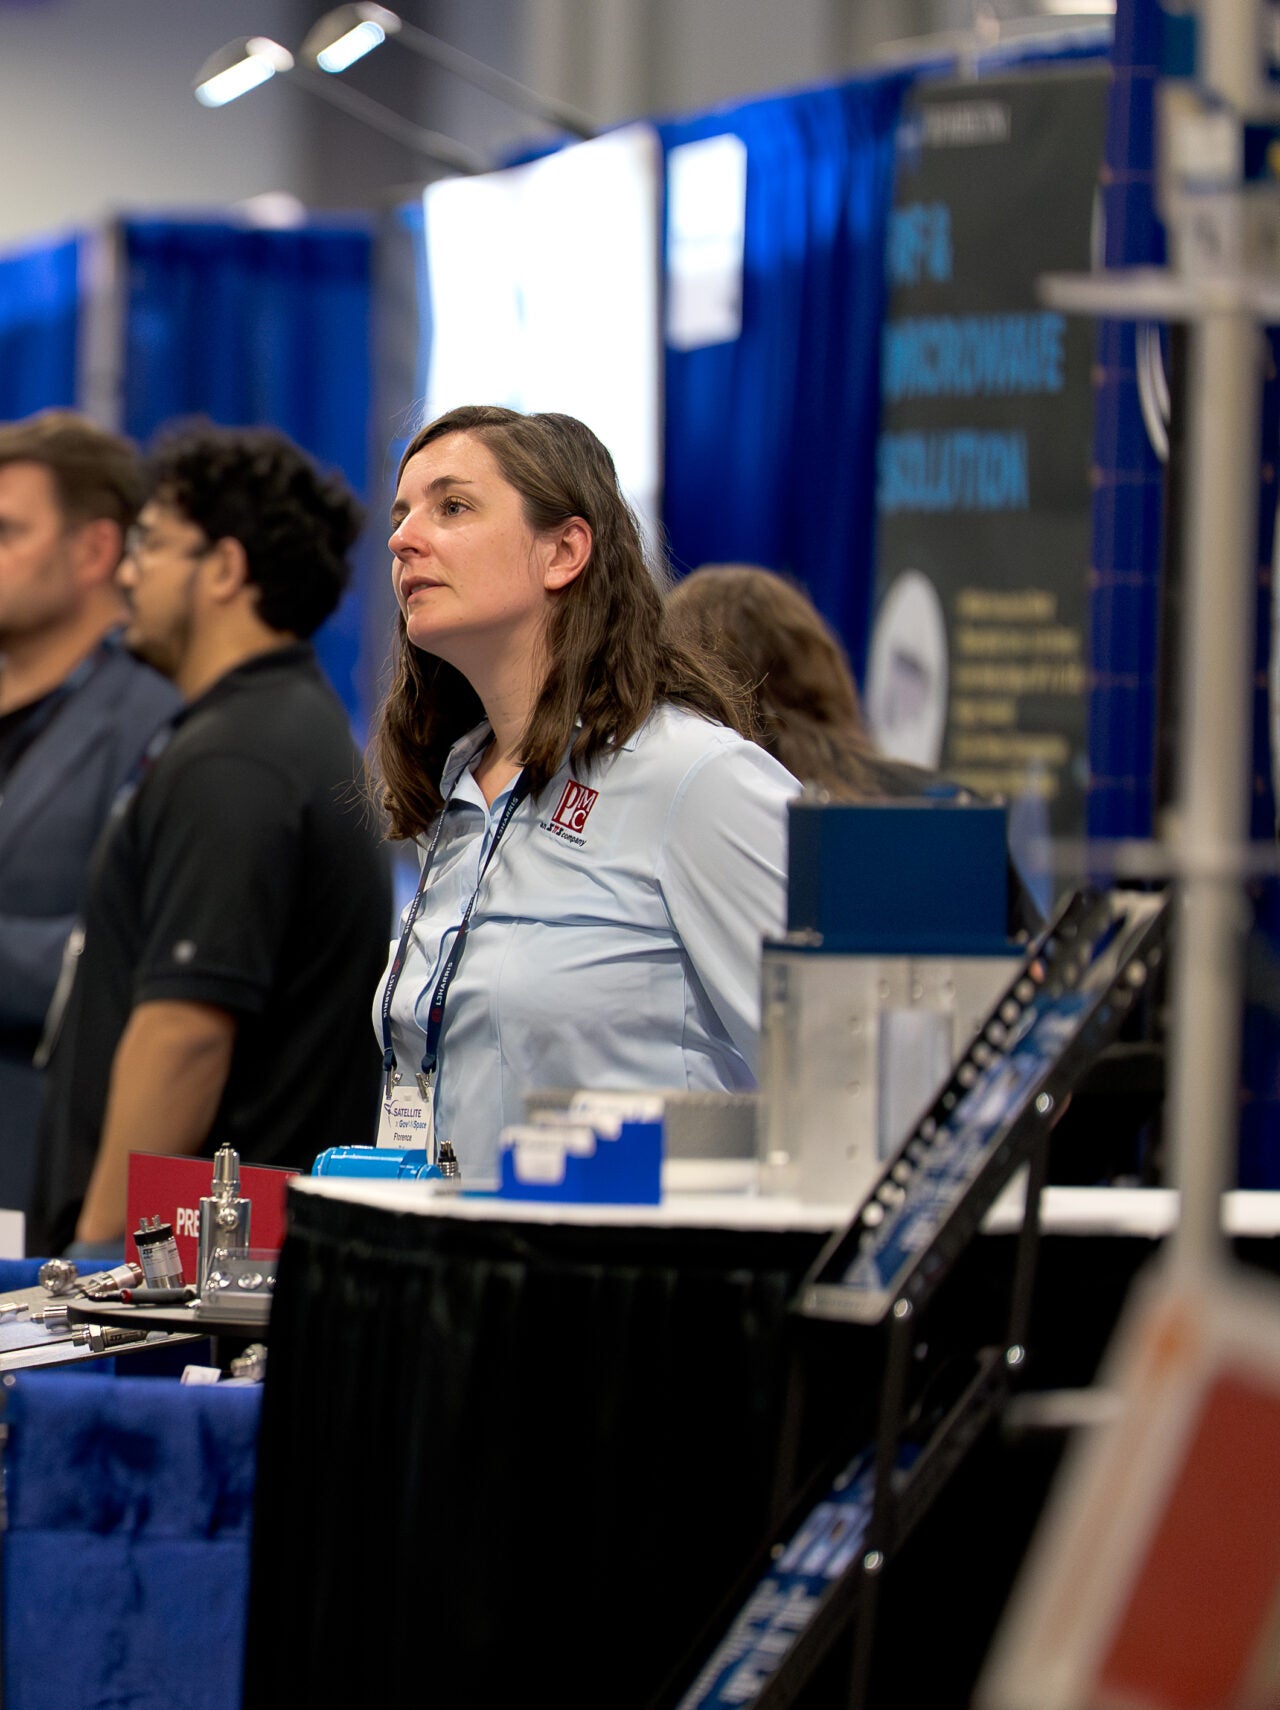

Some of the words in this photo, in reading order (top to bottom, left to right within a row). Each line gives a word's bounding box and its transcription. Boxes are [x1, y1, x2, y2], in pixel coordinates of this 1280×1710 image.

[553, 781, 597, 831] PMC
[561, 832, 587, 847] company
[436, 961, 453, 1006] L3HARRIS
[393, 1107, 422, 1118] SATELLITE
